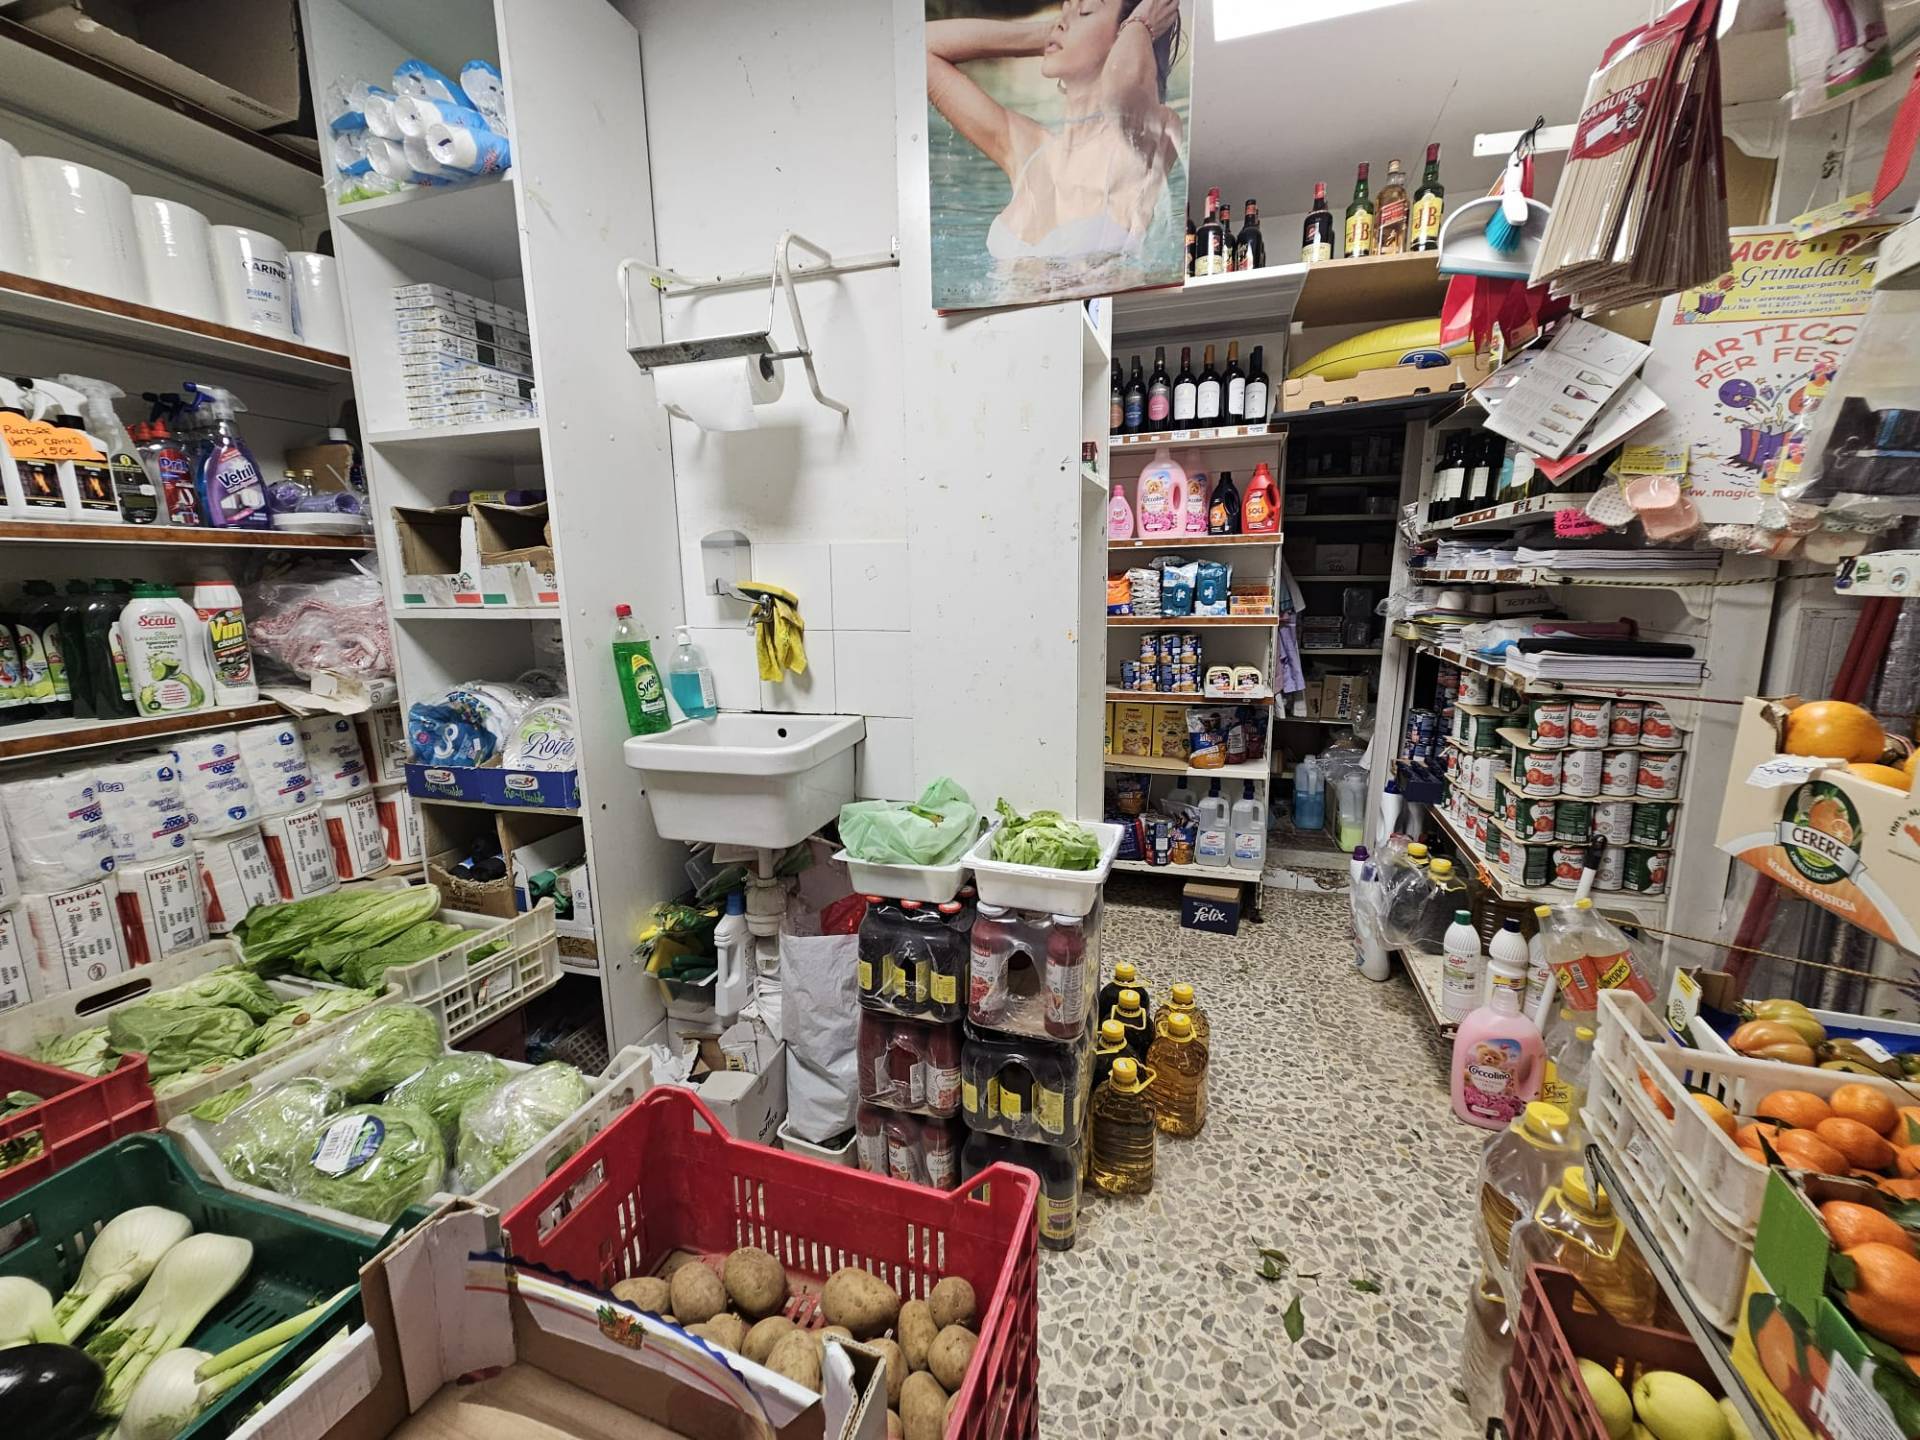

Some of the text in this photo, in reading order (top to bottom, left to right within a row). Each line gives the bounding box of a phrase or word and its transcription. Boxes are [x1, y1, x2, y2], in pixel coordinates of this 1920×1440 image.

[1581, 81, 1649, 121] SAMURAI
[1741, 257, 1850, 289] Grimaldi
[1695, 356, 1758, 390] PER
[217, 461, 255, 488] Vetril
[138, 615, 176, 627] Scala
[208, 620, 243, 642] Vim
[1792, 827, 1844, 862] CERERE
[1192, 906, 1226, 924] felix
[1468, 1064, 1511, 1080] Coccolino
